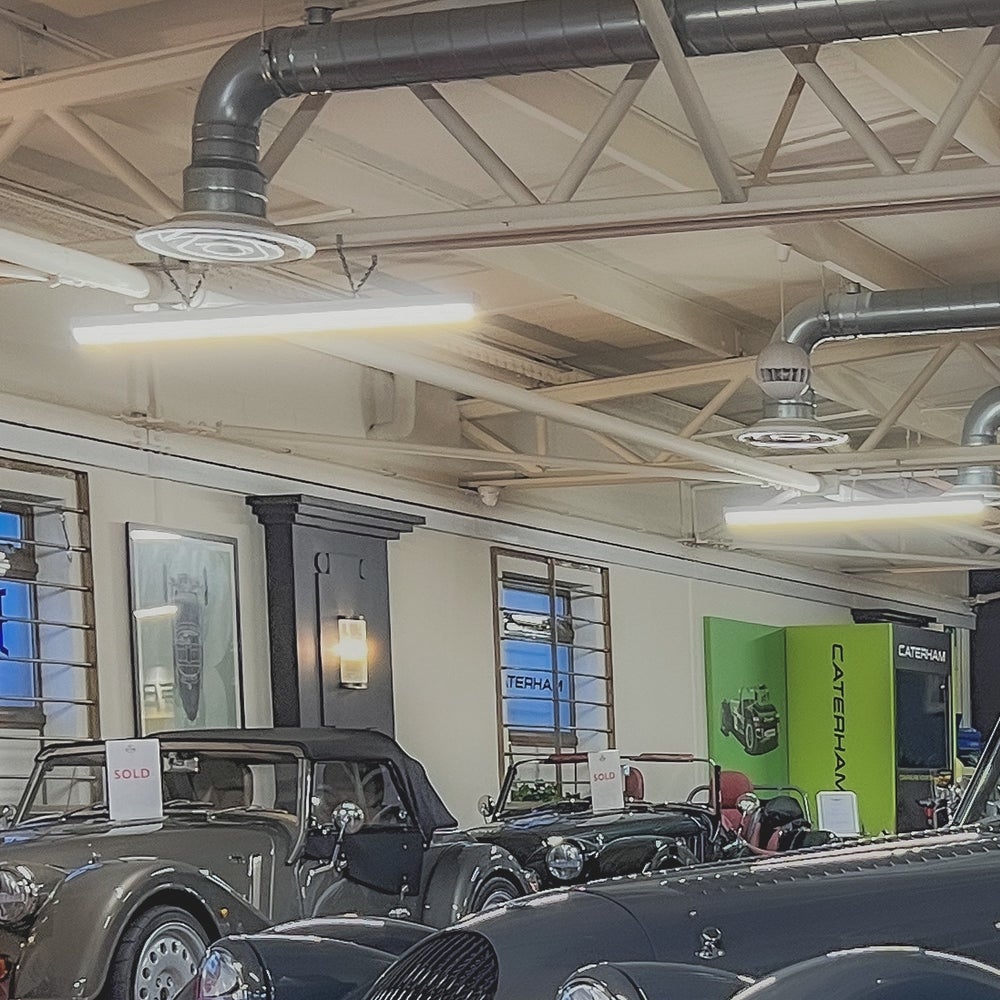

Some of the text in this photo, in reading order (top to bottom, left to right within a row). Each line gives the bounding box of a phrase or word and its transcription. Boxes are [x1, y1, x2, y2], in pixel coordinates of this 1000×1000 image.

[897, 644, 946, 663] CATERHAM
[114, 768, 150, 780] SOLD
[593, 771, 616, 782] SOLD
